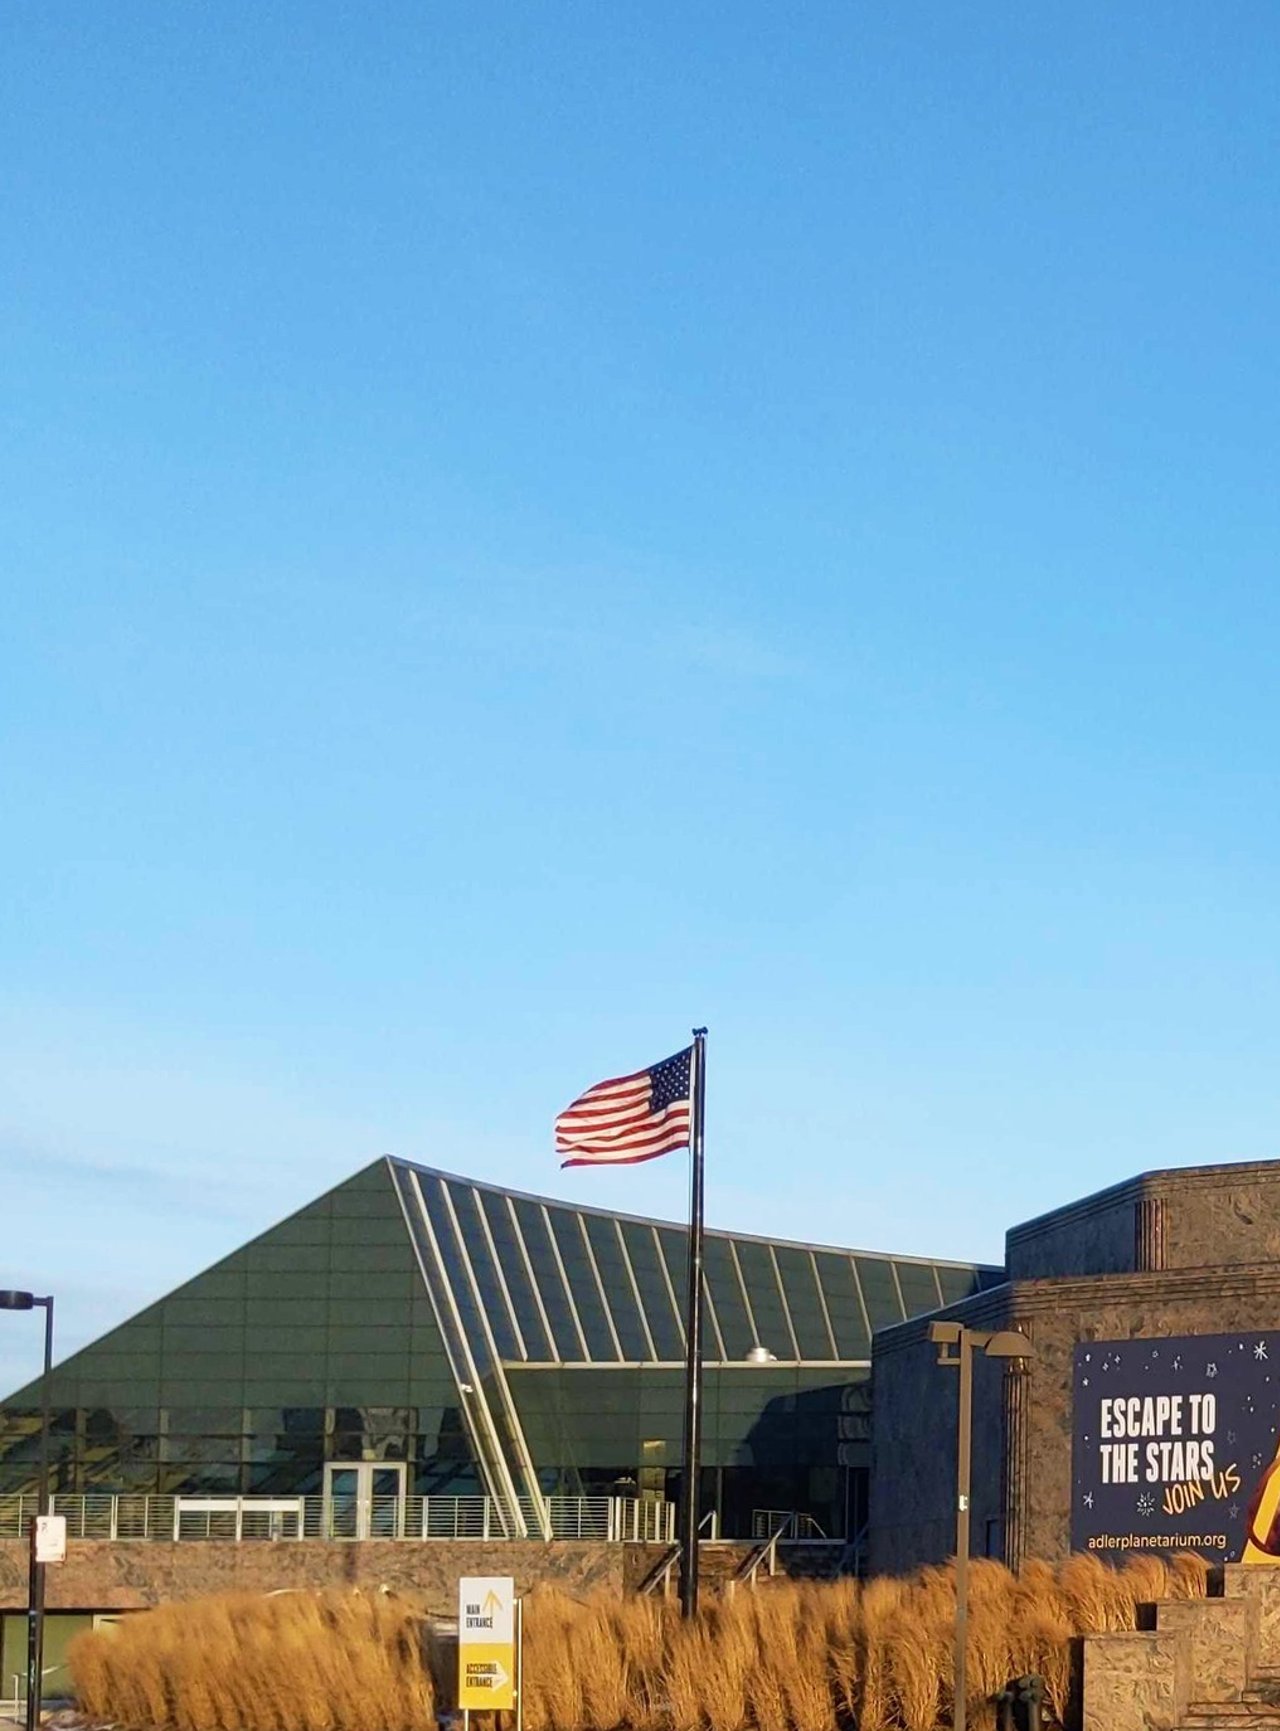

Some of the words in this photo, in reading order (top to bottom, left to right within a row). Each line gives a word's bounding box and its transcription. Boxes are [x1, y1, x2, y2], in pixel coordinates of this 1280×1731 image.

[1101, 1395, 1183, 1438] ESCAPE
[1189, 1393, 1216, 1435] TO
[1100, 1443, 1139, 1484] THE
[1146, 1439, 1214, 1483] STARS
[1162, 1478, 1205, 1516] JOIN
[1210, 1462, 1241, 1500] US
[1088, 1532, 1227, 1551] adlerplanetarium.org
[466, 1617, 493, 1629] ENTRANCE
